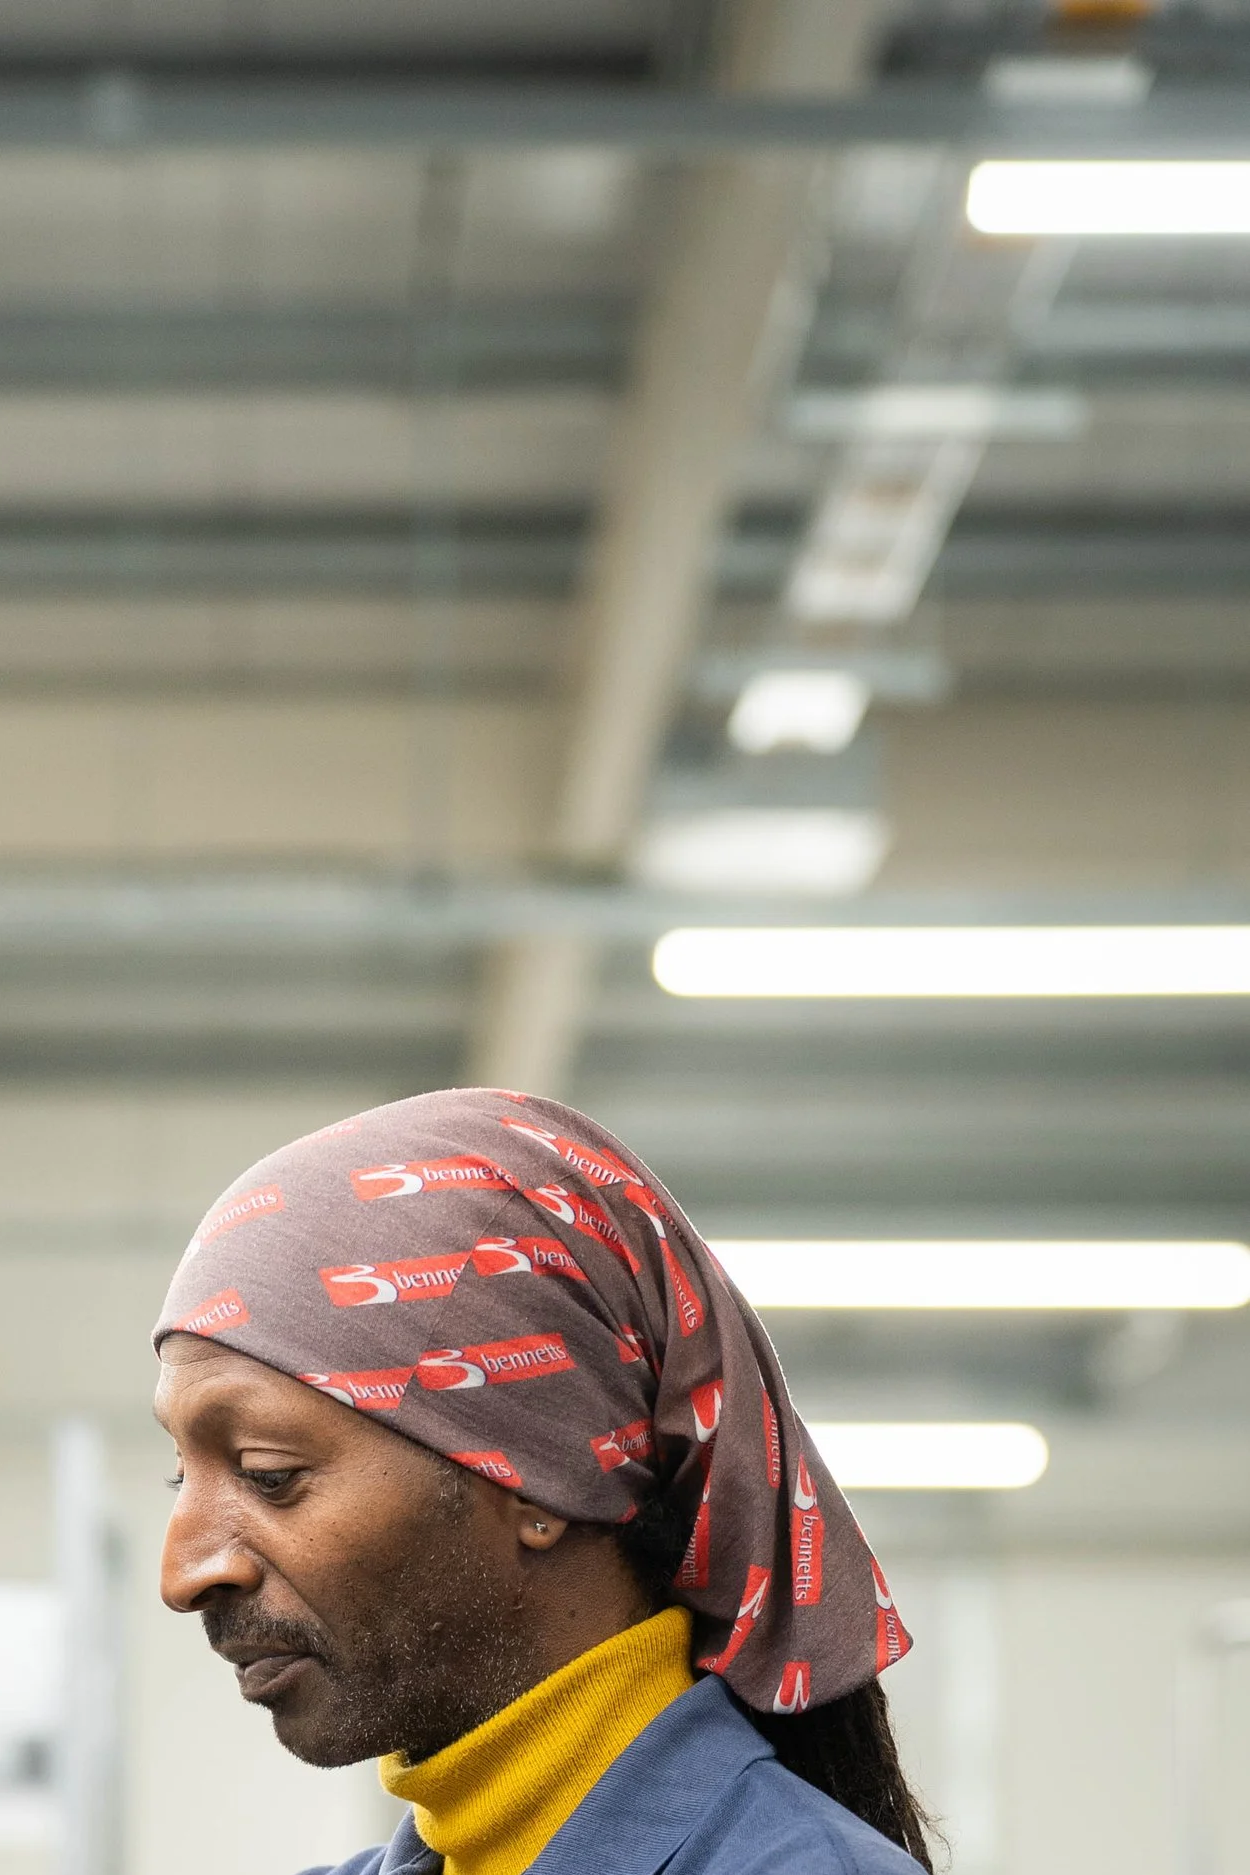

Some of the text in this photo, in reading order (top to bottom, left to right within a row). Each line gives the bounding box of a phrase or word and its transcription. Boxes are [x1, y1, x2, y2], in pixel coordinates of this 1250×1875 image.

[392, 1263, 465, 1290] benne
[481, 1343, 567, 1373] bennetts
[348, 1380, 408, 1399] benn
[795, 1514, 819, 1601] bennetts
